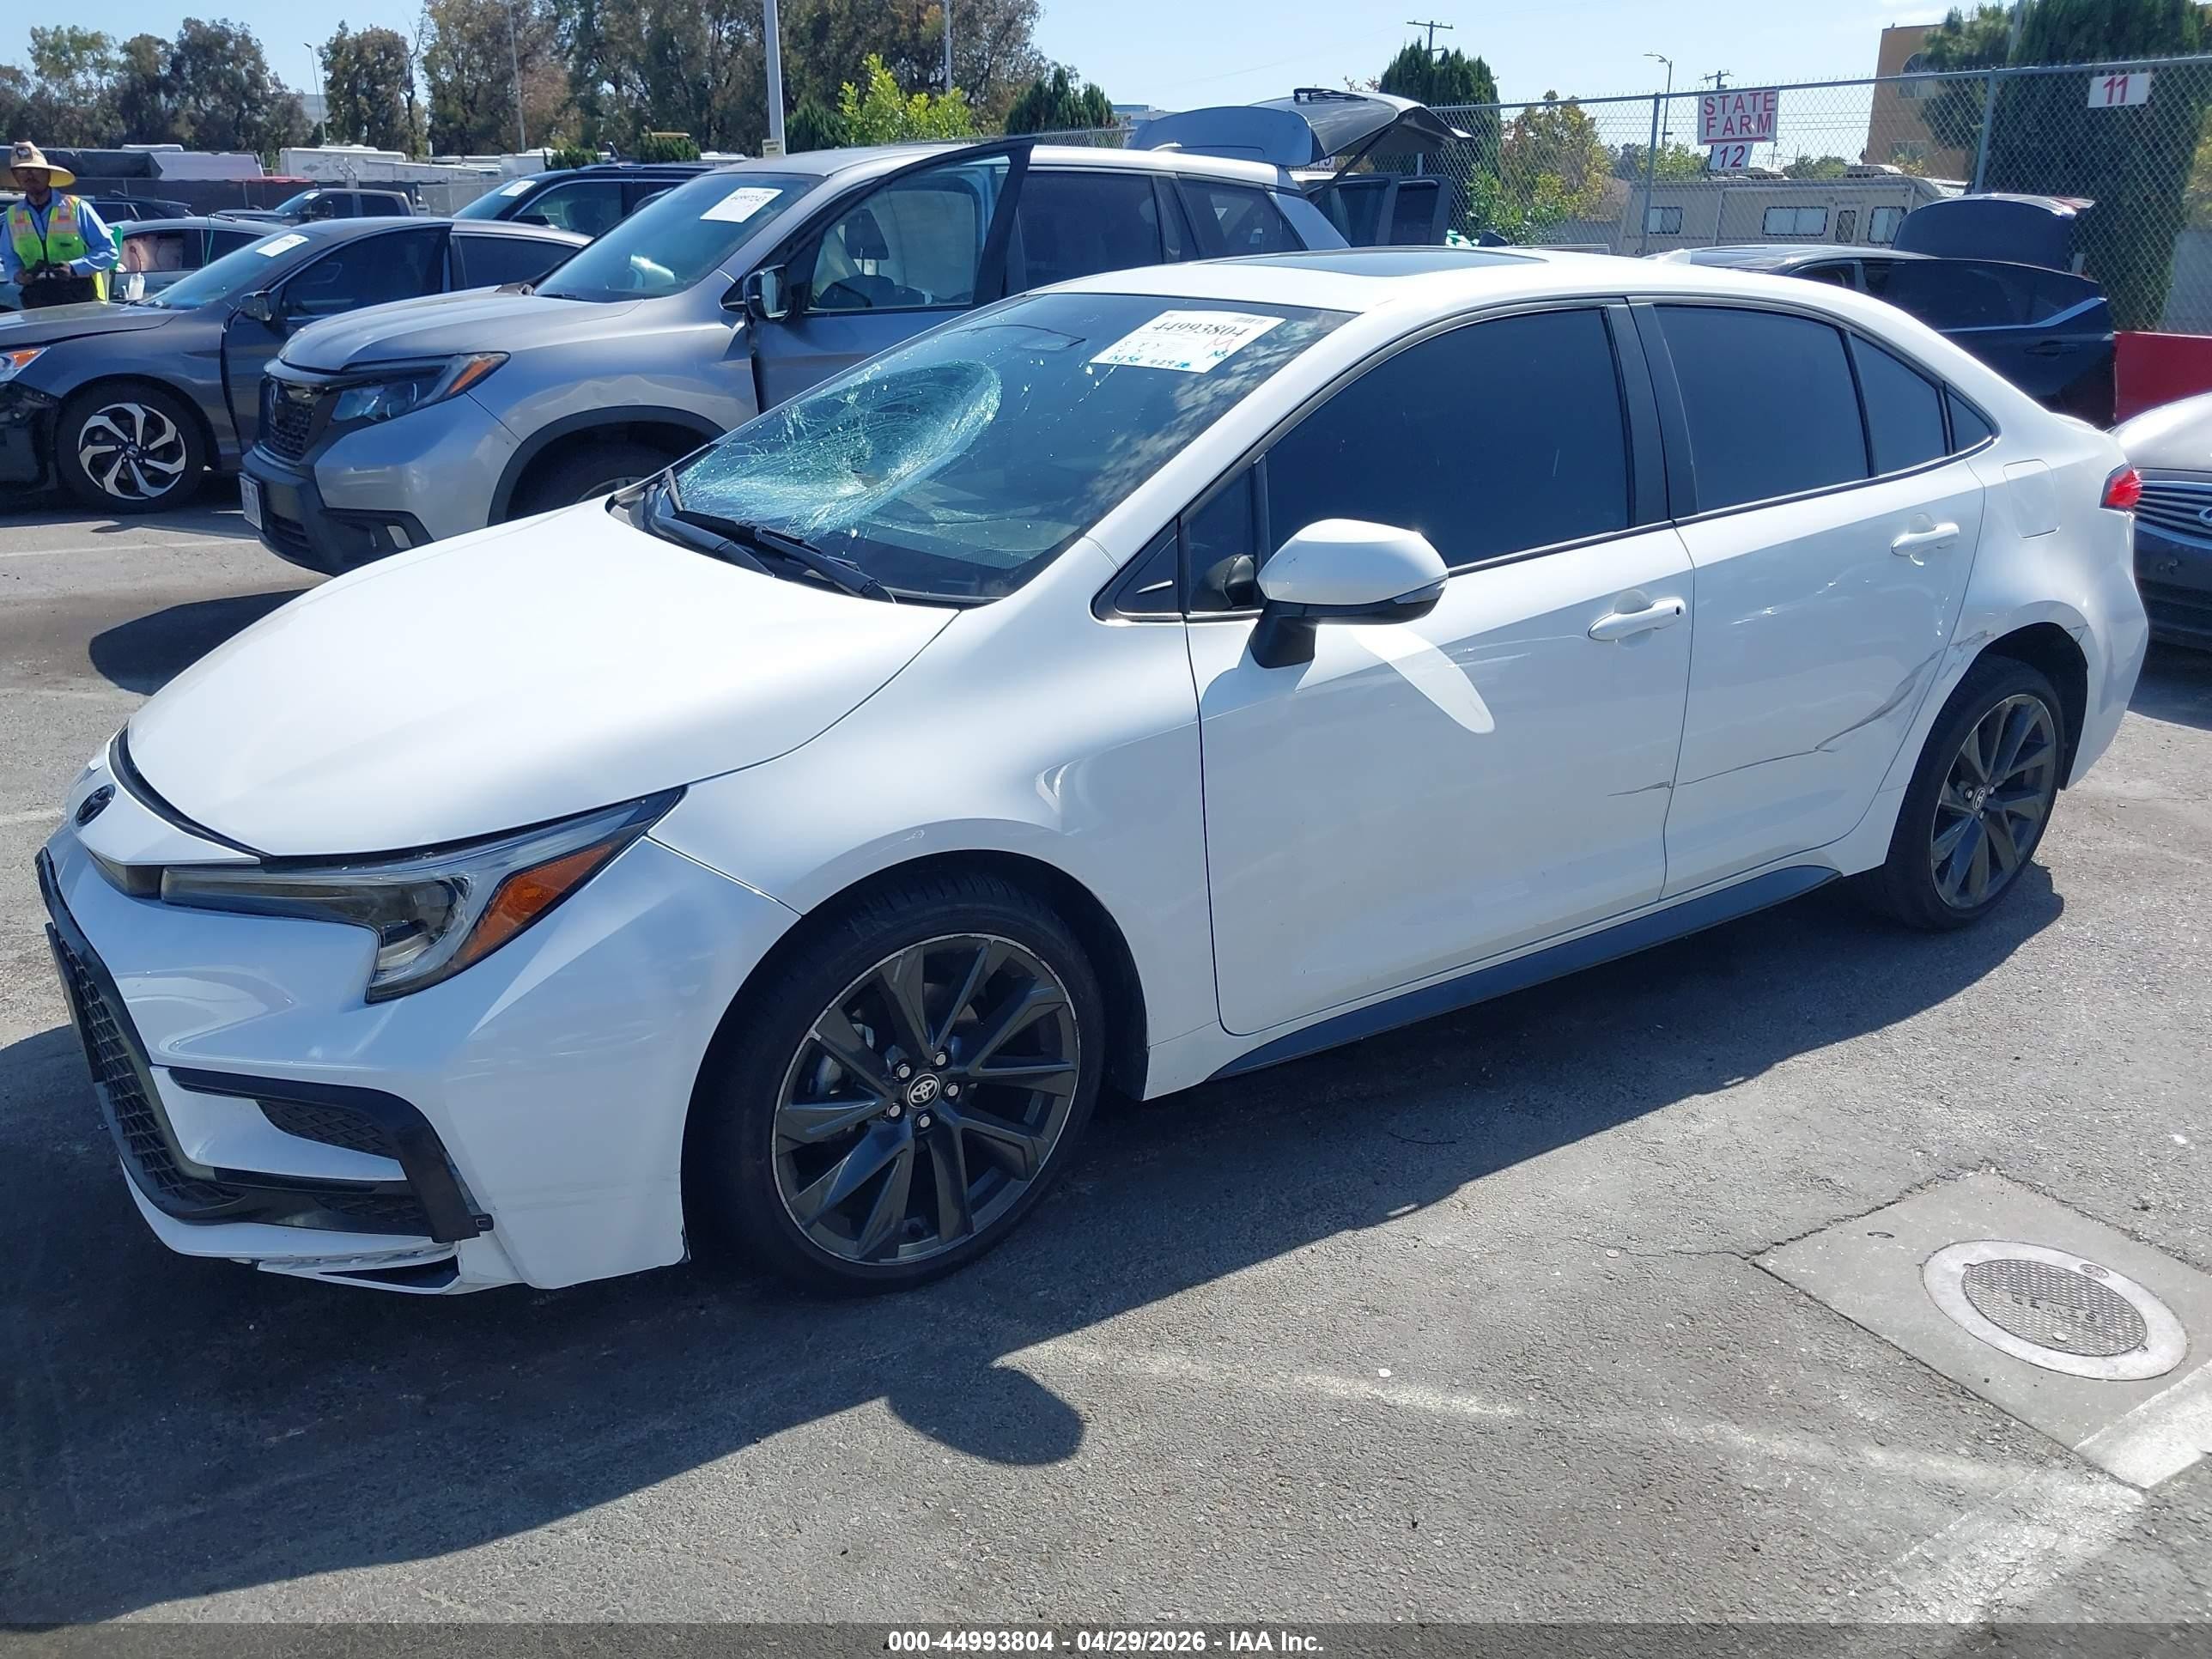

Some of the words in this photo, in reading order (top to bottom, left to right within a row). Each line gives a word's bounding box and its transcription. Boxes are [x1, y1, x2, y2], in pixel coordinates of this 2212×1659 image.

[2102, 76, 2130, 105] 11
[1703, 91, 1777, 116] STATE
[1705, 112, 1772, 137] FARM
[1719, 145, 1746, 168] 12
[1152, 321, 1250, 337] 44993804
